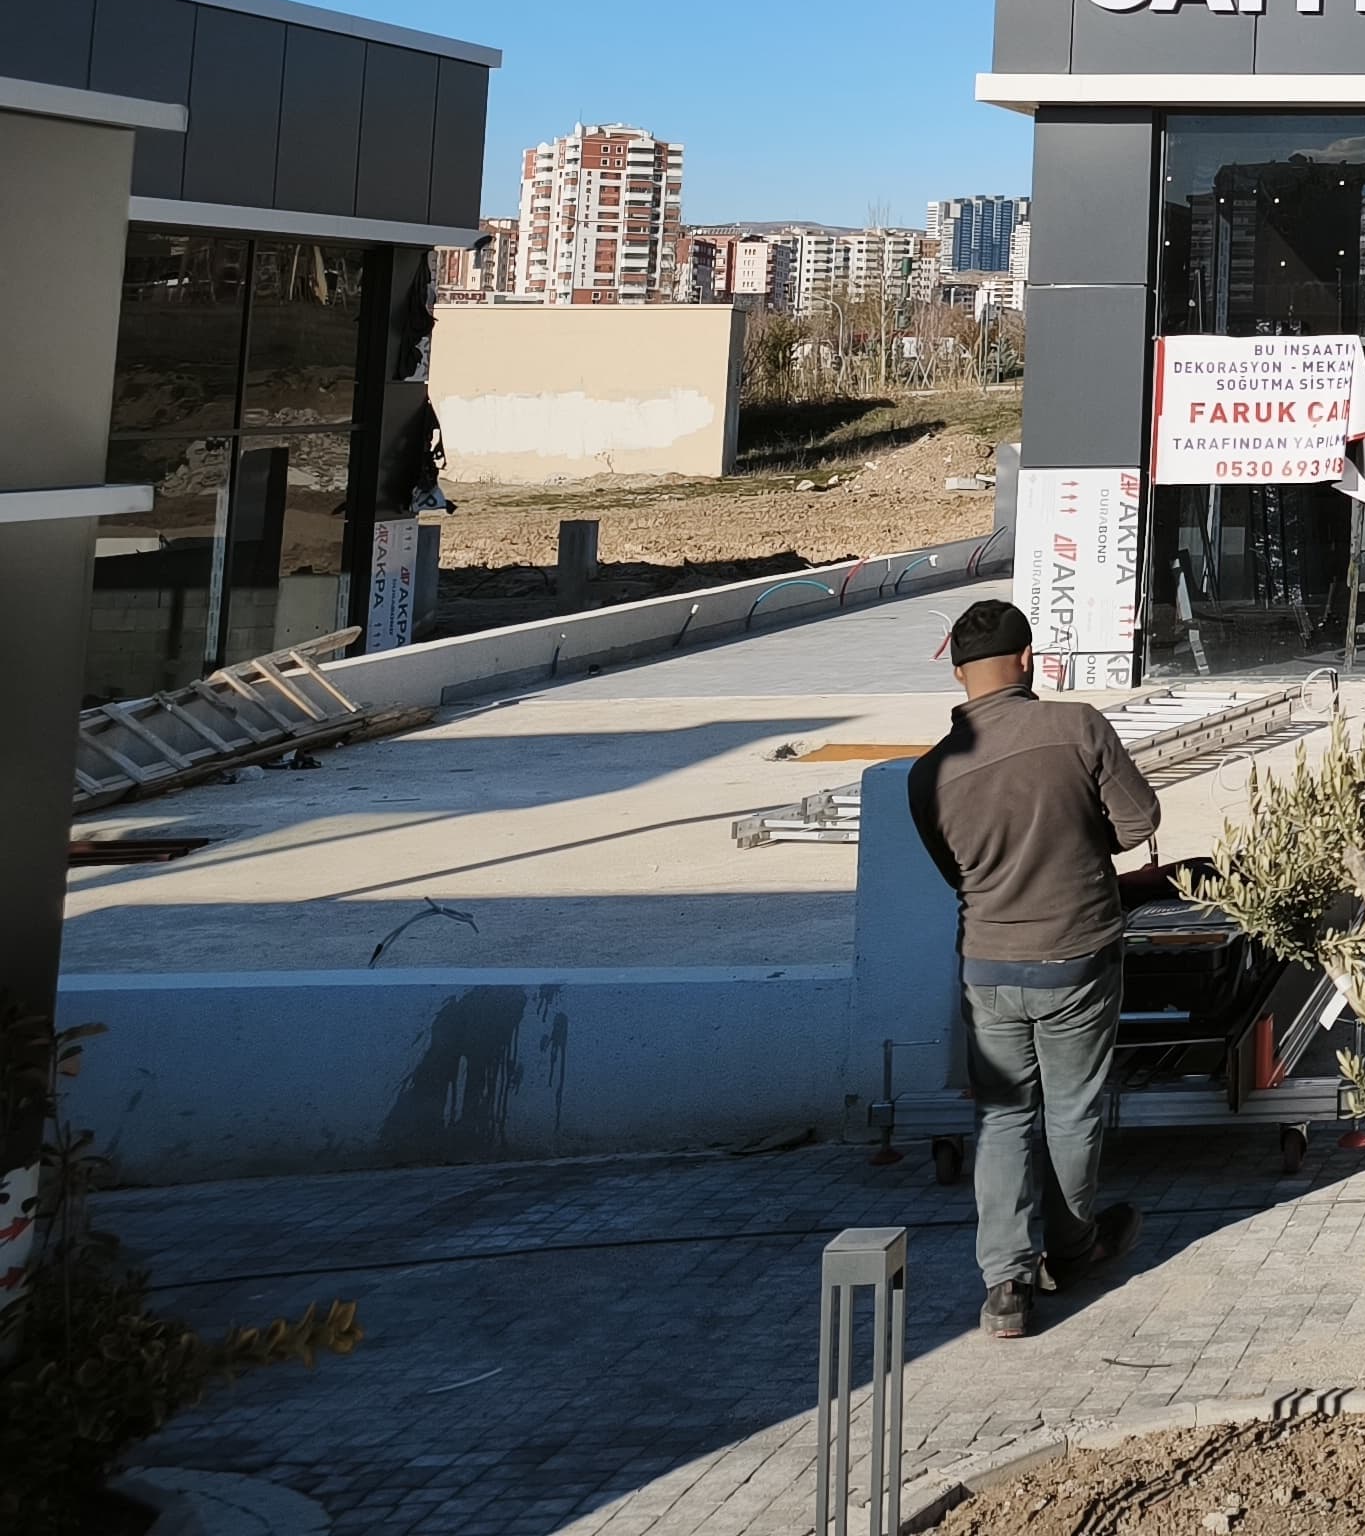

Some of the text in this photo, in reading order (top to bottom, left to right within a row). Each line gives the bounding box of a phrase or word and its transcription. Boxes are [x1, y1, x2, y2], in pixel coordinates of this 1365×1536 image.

[1174, 361, 1282, 374] DEKORASYON
[1254, 344, 1274, 356] BU
[1216, 375, 1294, 391] SOĞUTMA
[1189, 401, 1296, 424] FARUK
[1173, 437, 1287, 450] TARAFINDAN
[1216, 461, 1273, 477] 0530
[1096, 488, 1110, 564] DURABOND
[1116, 501, 1138, 585] AKPA
[373, 546, 388, 609] AKPA
[1030, 550, 1043, 626] DURABOND
[395, 587, 409, 648] AKPA
[1050, 562, 1076, 648] AKPA
